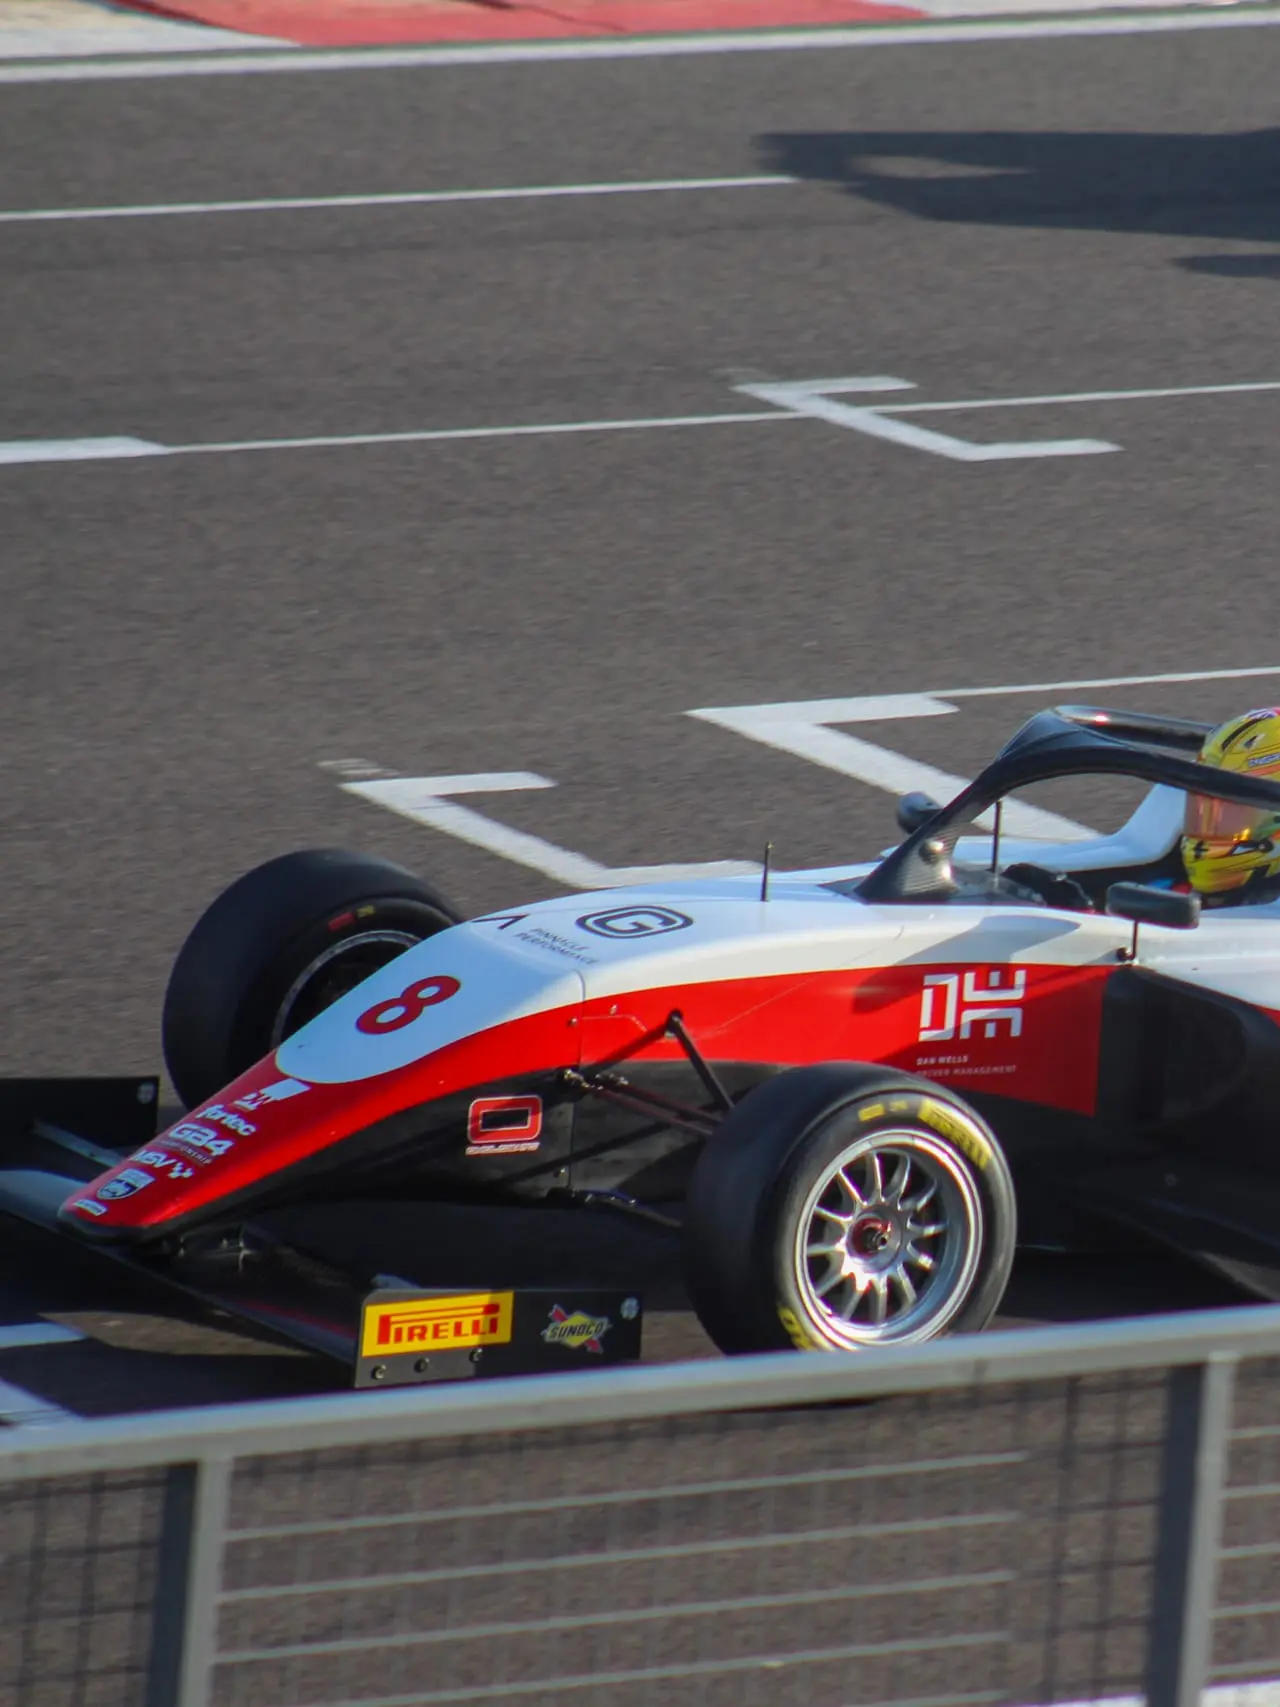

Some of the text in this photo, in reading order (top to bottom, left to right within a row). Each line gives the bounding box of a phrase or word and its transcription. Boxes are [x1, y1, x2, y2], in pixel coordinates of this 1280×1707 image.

[356, 975, 461, 1035] 8
[195, 1104, 257, 1136] fortec
[167, 1123, 235, 1157] GB4
[377, 1302, 500, 1345] PIRELLI
[549, 1320, 605, 1340] SUNOCO
